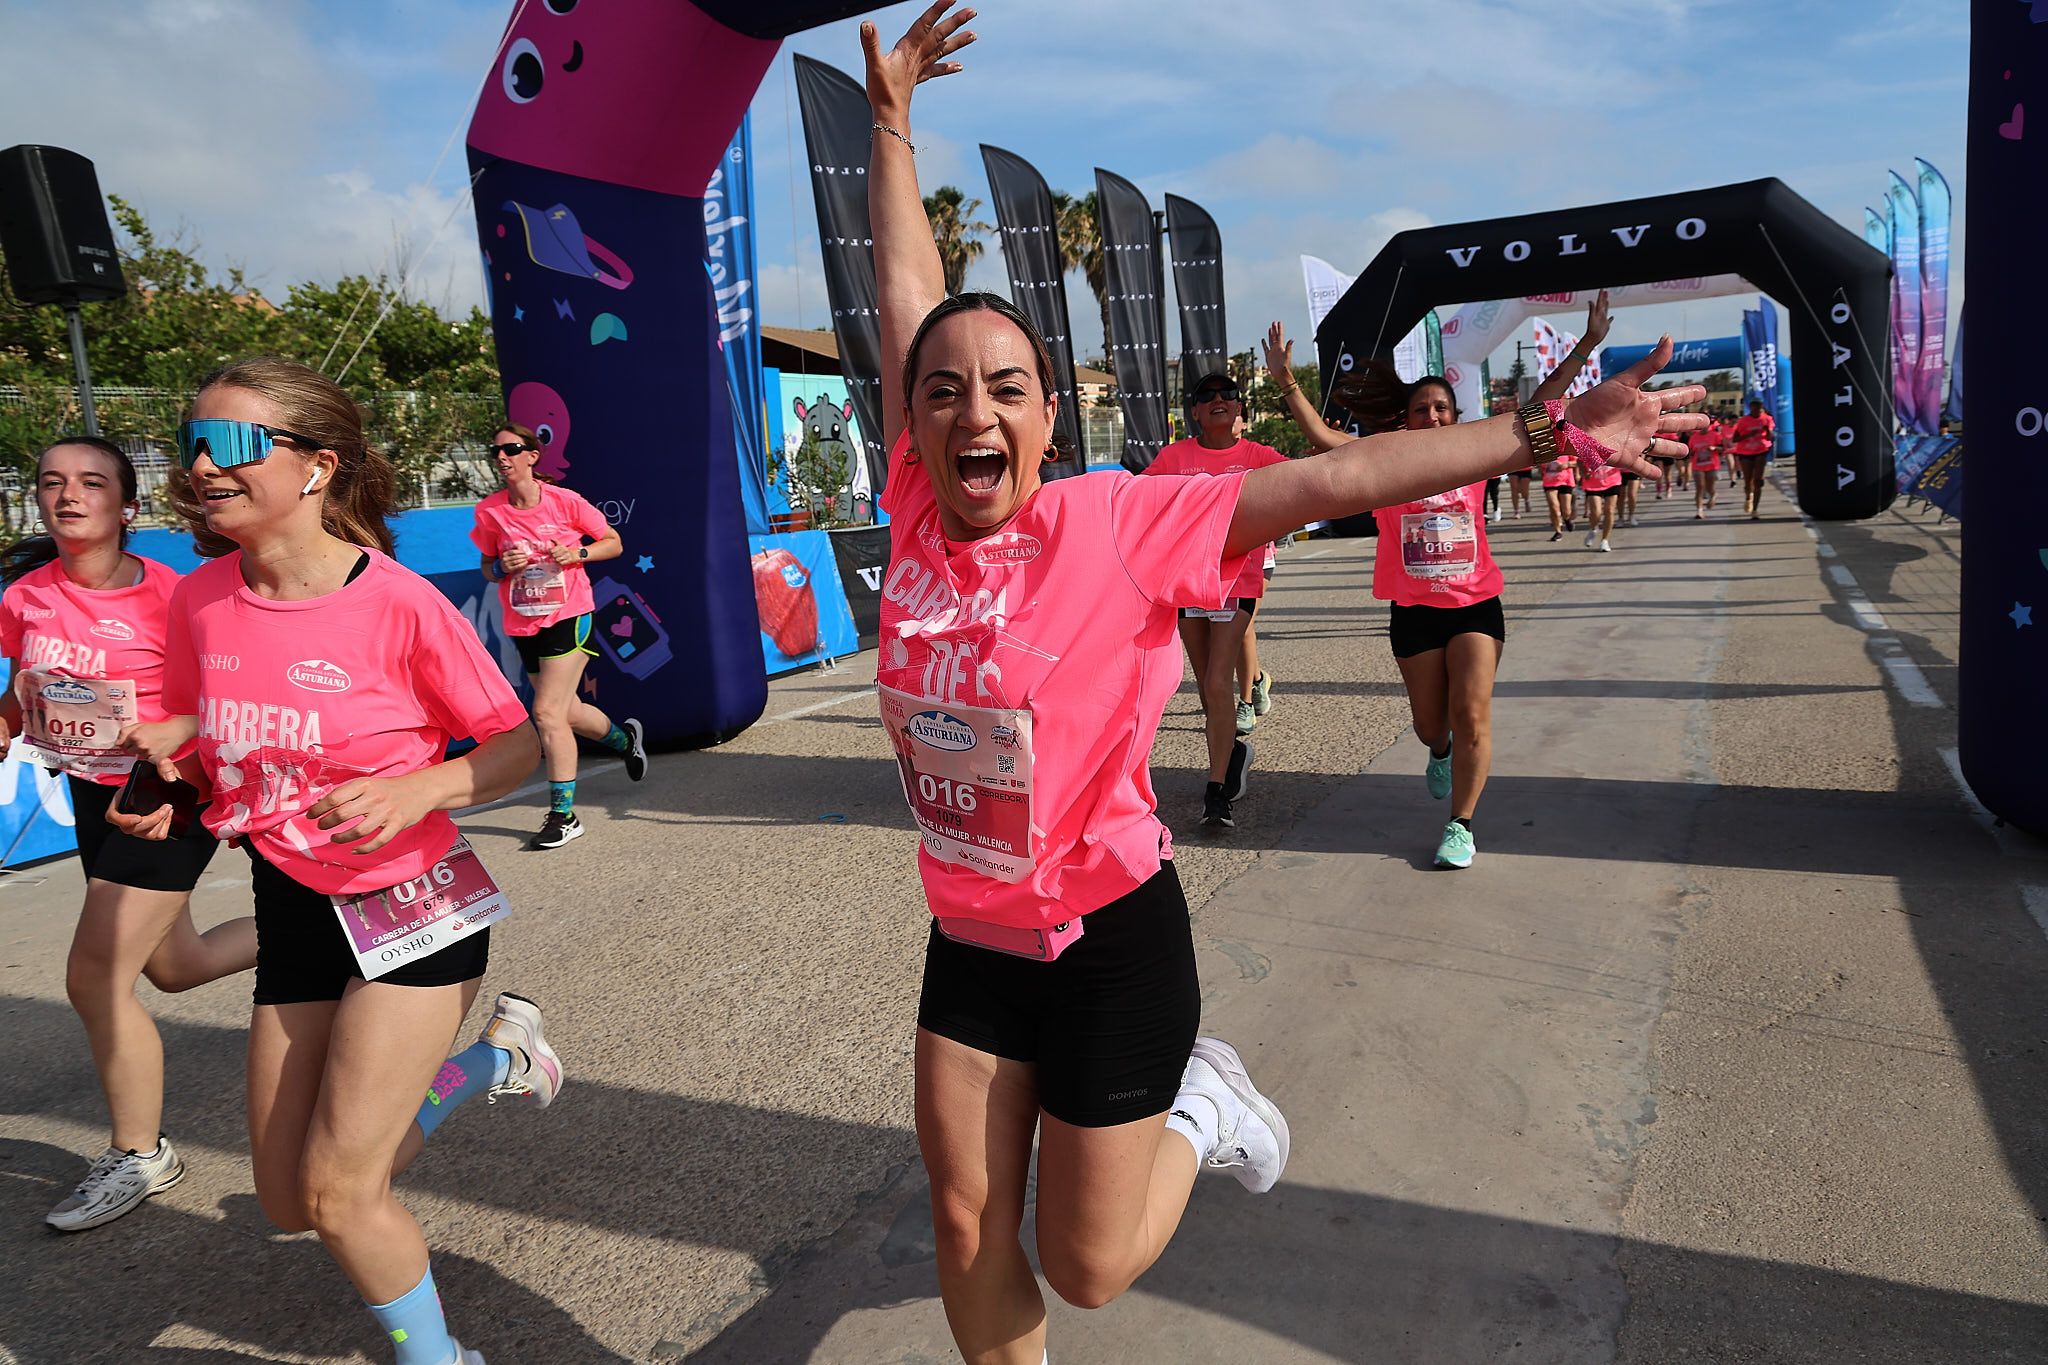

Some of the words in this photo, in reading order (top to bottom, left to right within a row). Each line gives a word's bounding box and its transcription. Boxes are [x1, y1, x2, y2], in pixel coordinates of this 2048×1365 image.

[1446, 217, 1707, 268] VOLVO
[1830, 302, 1856, 490] VOLVO
[979, 546, 1036, 562] ASTURIANA
[1425, 542, 1454, 553] 016
[525, 586, 547, 597] 016
[1430, 582, 1450, 592] 2026
[292, 668, 345, 687] ASTURIANA
[48, 719, 96, 737] 016
[914, 720, 973, 746] ASTURIANA
[61, 738, 84, 747] 3927
[918, 774, 977, 811] 016
[936, 810, 962, 827] 1079
[935, 823, 945, 834] LA
[945, 826, 970, 842] MUJER
[977, 835, 1013, 853] VALENCIA
[968, 853, 1015, 875] Santander
[393, 861, 455, 903] 016
[423, 894, 445, 910] 679
[371, 925, 411, 946] CARRERA
[411, 919, 422, 930] DE
[422, 913, 434, 924] LA
[434, 901, 461, 917] MUJER
[464, 886, 491, 903] VALENCIA
[464, 903, 501, 926] Santander
[381, 933, 434, 962] OYSHO
[1108, 1088, 1148, 1101] DOMYOS
